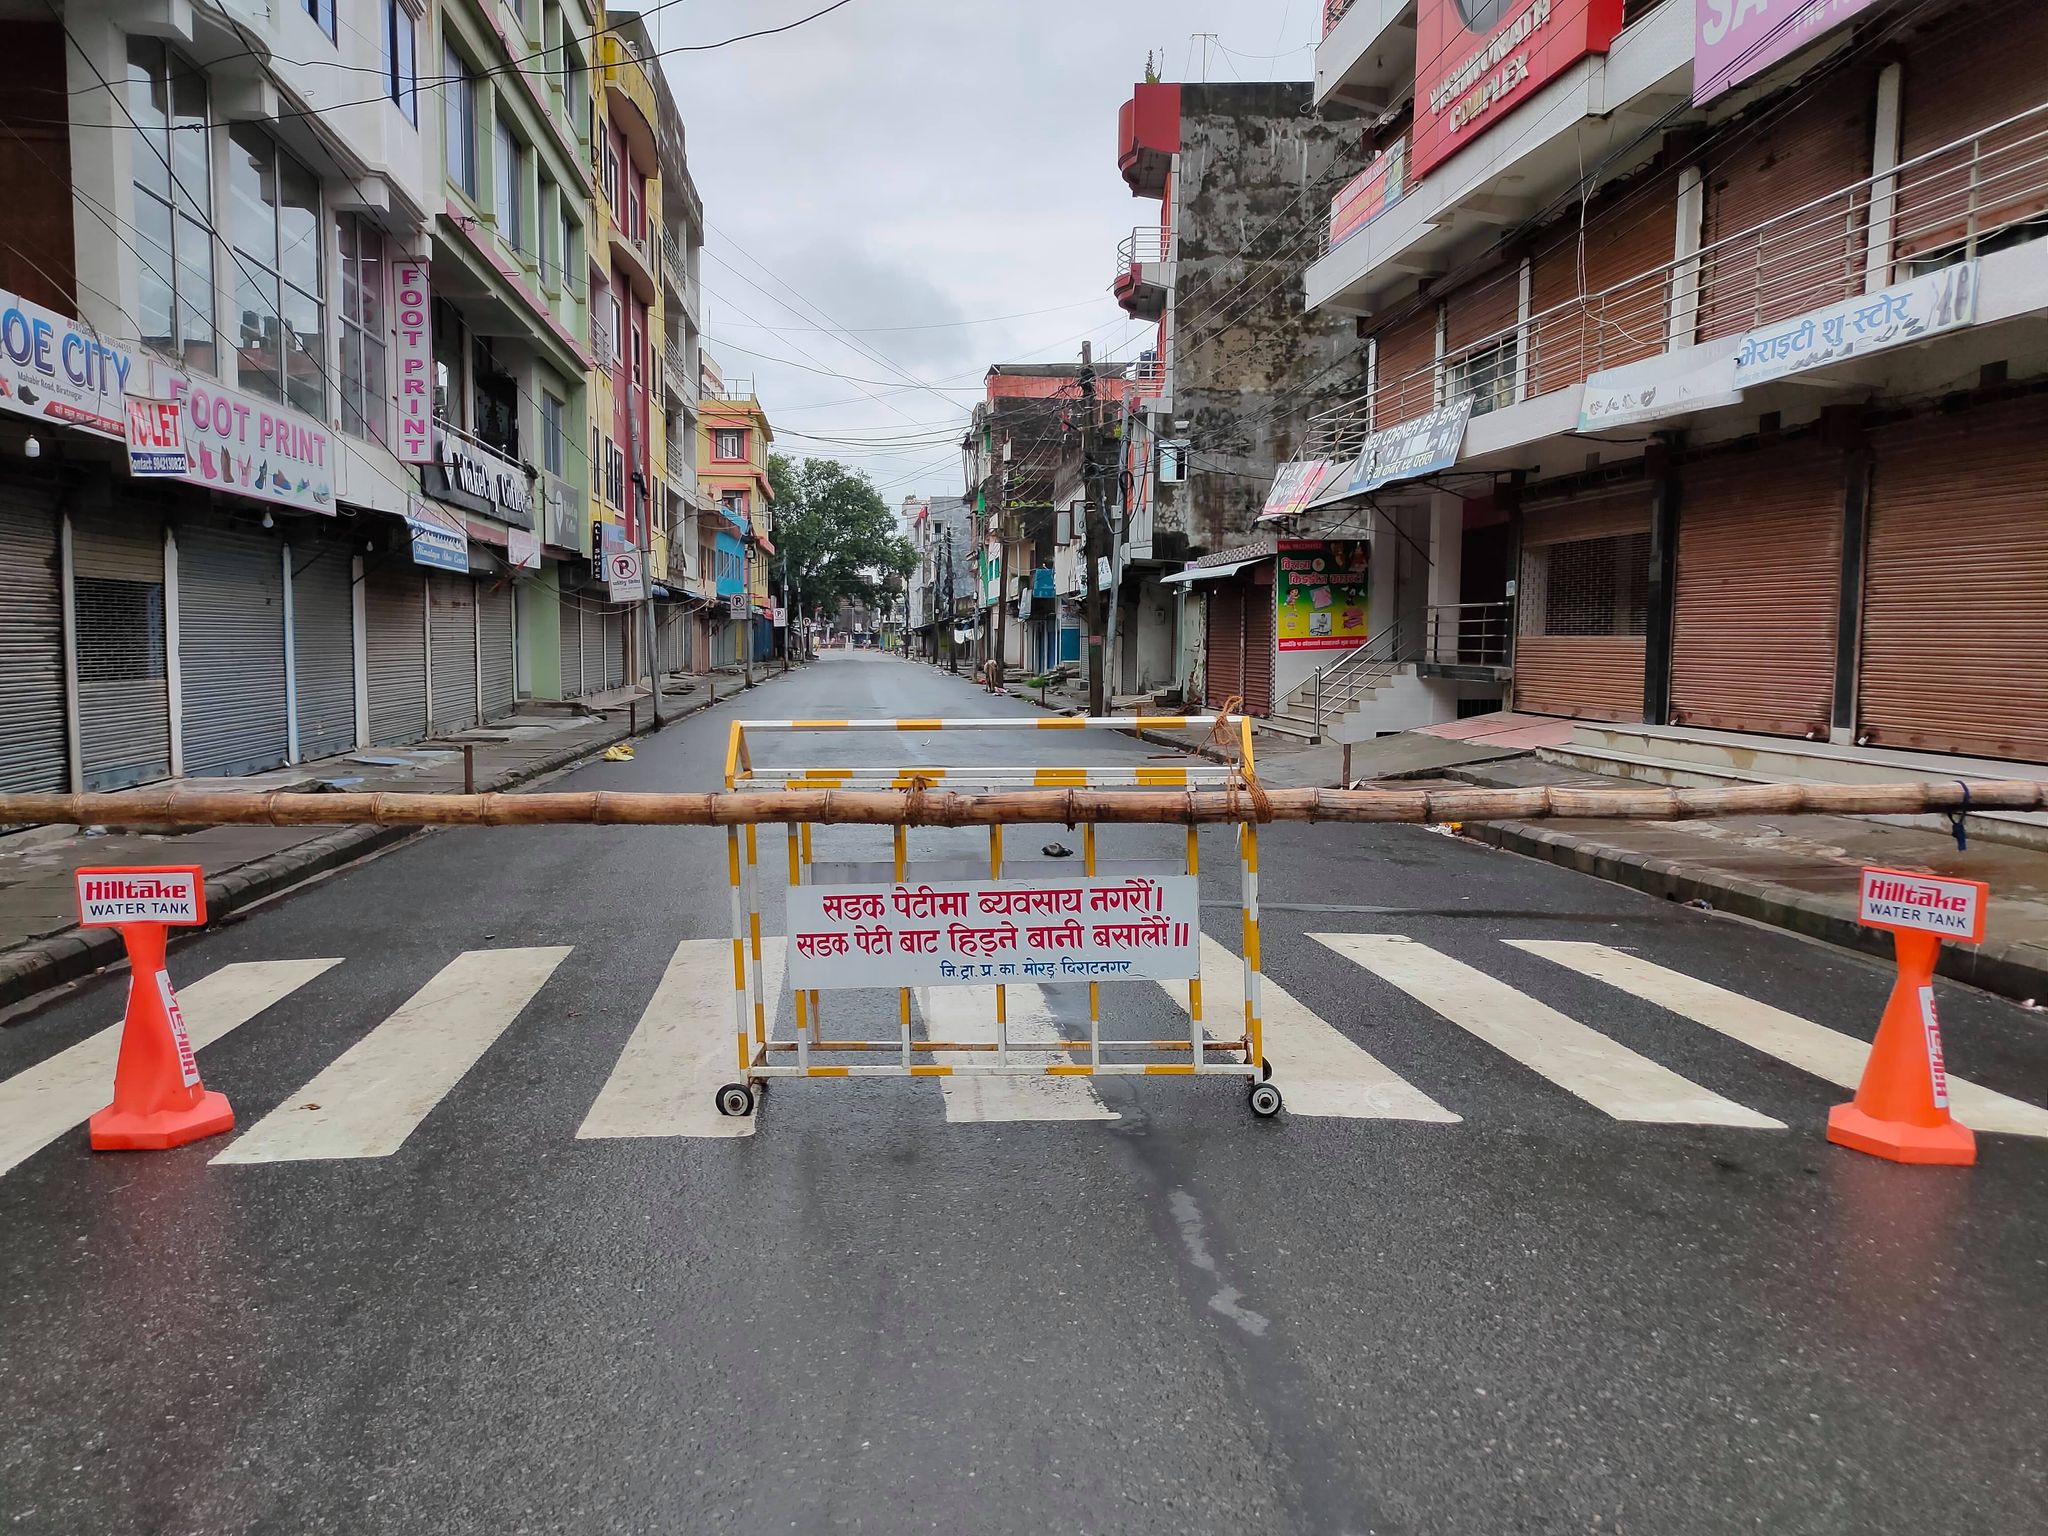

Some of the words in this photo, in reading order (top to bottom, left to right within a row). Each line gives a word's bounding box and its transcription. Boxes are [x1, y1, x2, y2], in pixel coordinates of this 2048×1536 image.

[1449, 49, 1530, 133] COMPLEX
[400, 270, 424, 348] FOOT
[0, 307, 54, 378] OE
[62, 332, 131, 396] CITY
[17, 371, 40, 386] Mahabir
[170, 378, 251, 444] FOOT
[259, 411, 327, 469] PRINT
[404, 359, 425, 456] PRINT
[1382, 418, 1422, 446] CORNER
[85, 880, 188, 901] Hilltake
[89, 903, 146, 916] WATER
[153, 902, 190, 915] TANK
[823, 894, 885, 922] सडक
[891, 885, 970, 919] पेटीमा
[1868, 878, 1967, 912] Hilltake
[1869, 903, 1921, 921] WATER
[1927, 911, 1967, 929] TANK
[796, 933, 849, 960] सडक
[854, 925, 893, 955] पेटी
[899, 930, 941, 956] बाट
[1026, 918, 1085, 950] बानी
